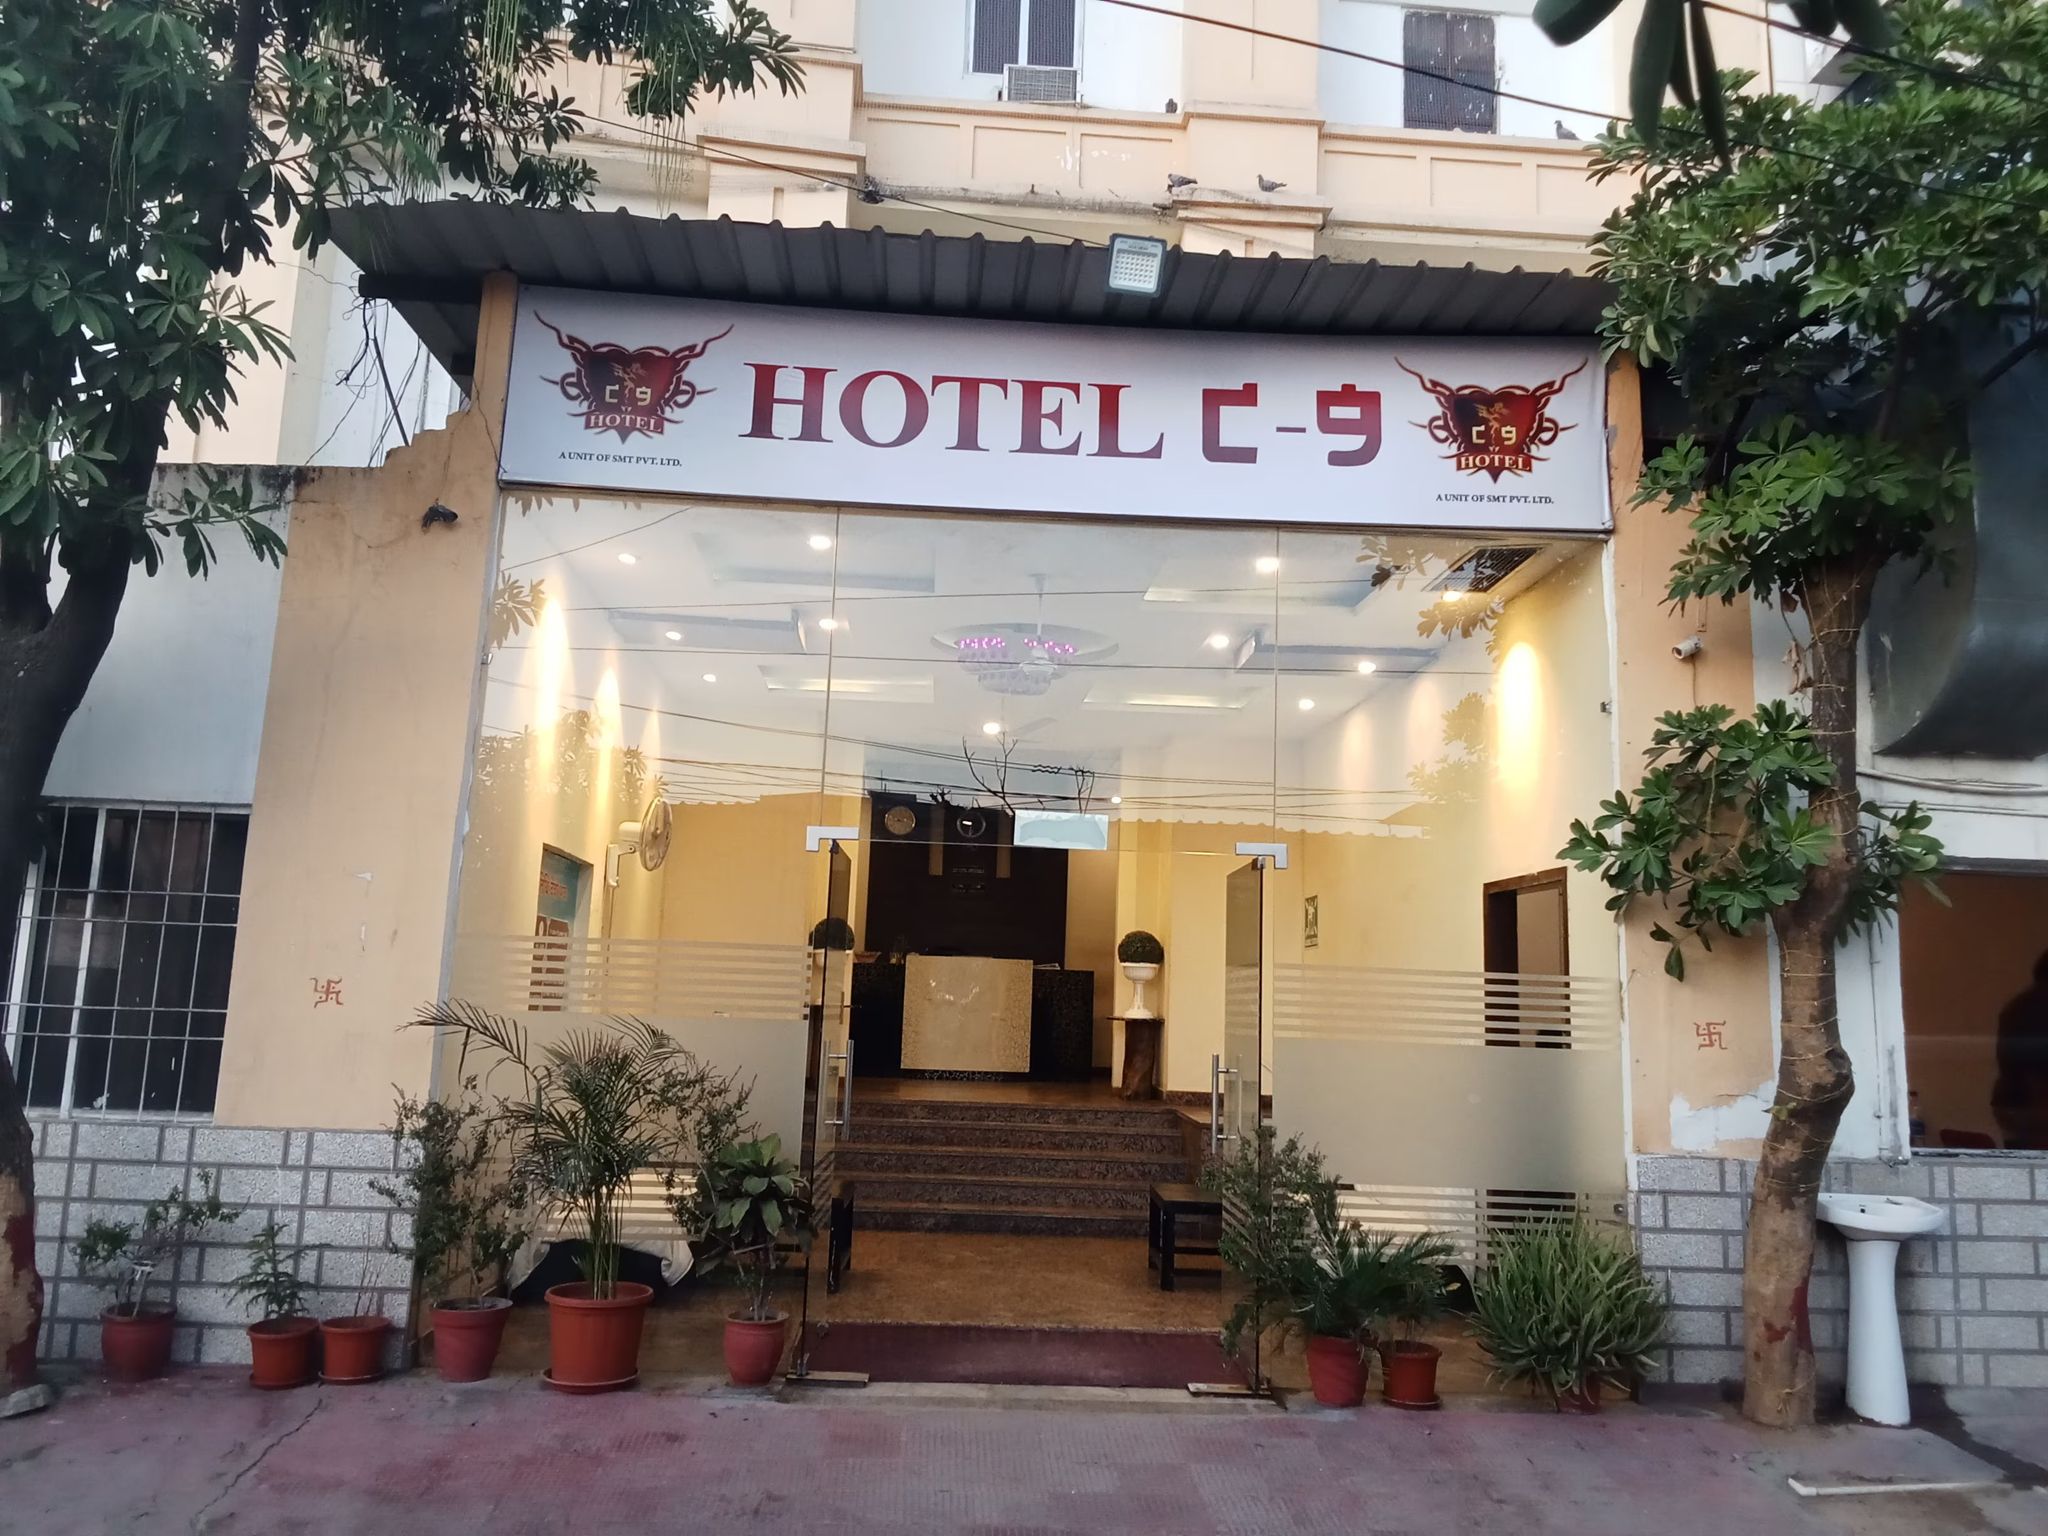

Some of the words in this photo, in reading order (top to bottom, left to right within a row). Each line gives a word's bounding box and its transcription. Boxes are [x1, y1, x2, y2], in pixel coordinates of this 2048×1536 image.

[738, 362, 1164, 459] HOTEL
[590, 414, 661, 431] HOTEL
[568, 452, 595, 461] UNIT
[596, 454, 611, 462] OF
[612, 455, 634, 464] SMT
[636, 456, 658, 466] PVT.
[660, 457, 682, 467] LTD.
[1461, 455, 1530, 470] HOTEL
[1436, 494, 1443, 502] A
[1444, 494, 1469, 502] UNIT
[1487, 495, 1507, 503] SMT
[1509, 496, 1531, 504] PVT.
[1532, 496, 1555, 504] LTD.
